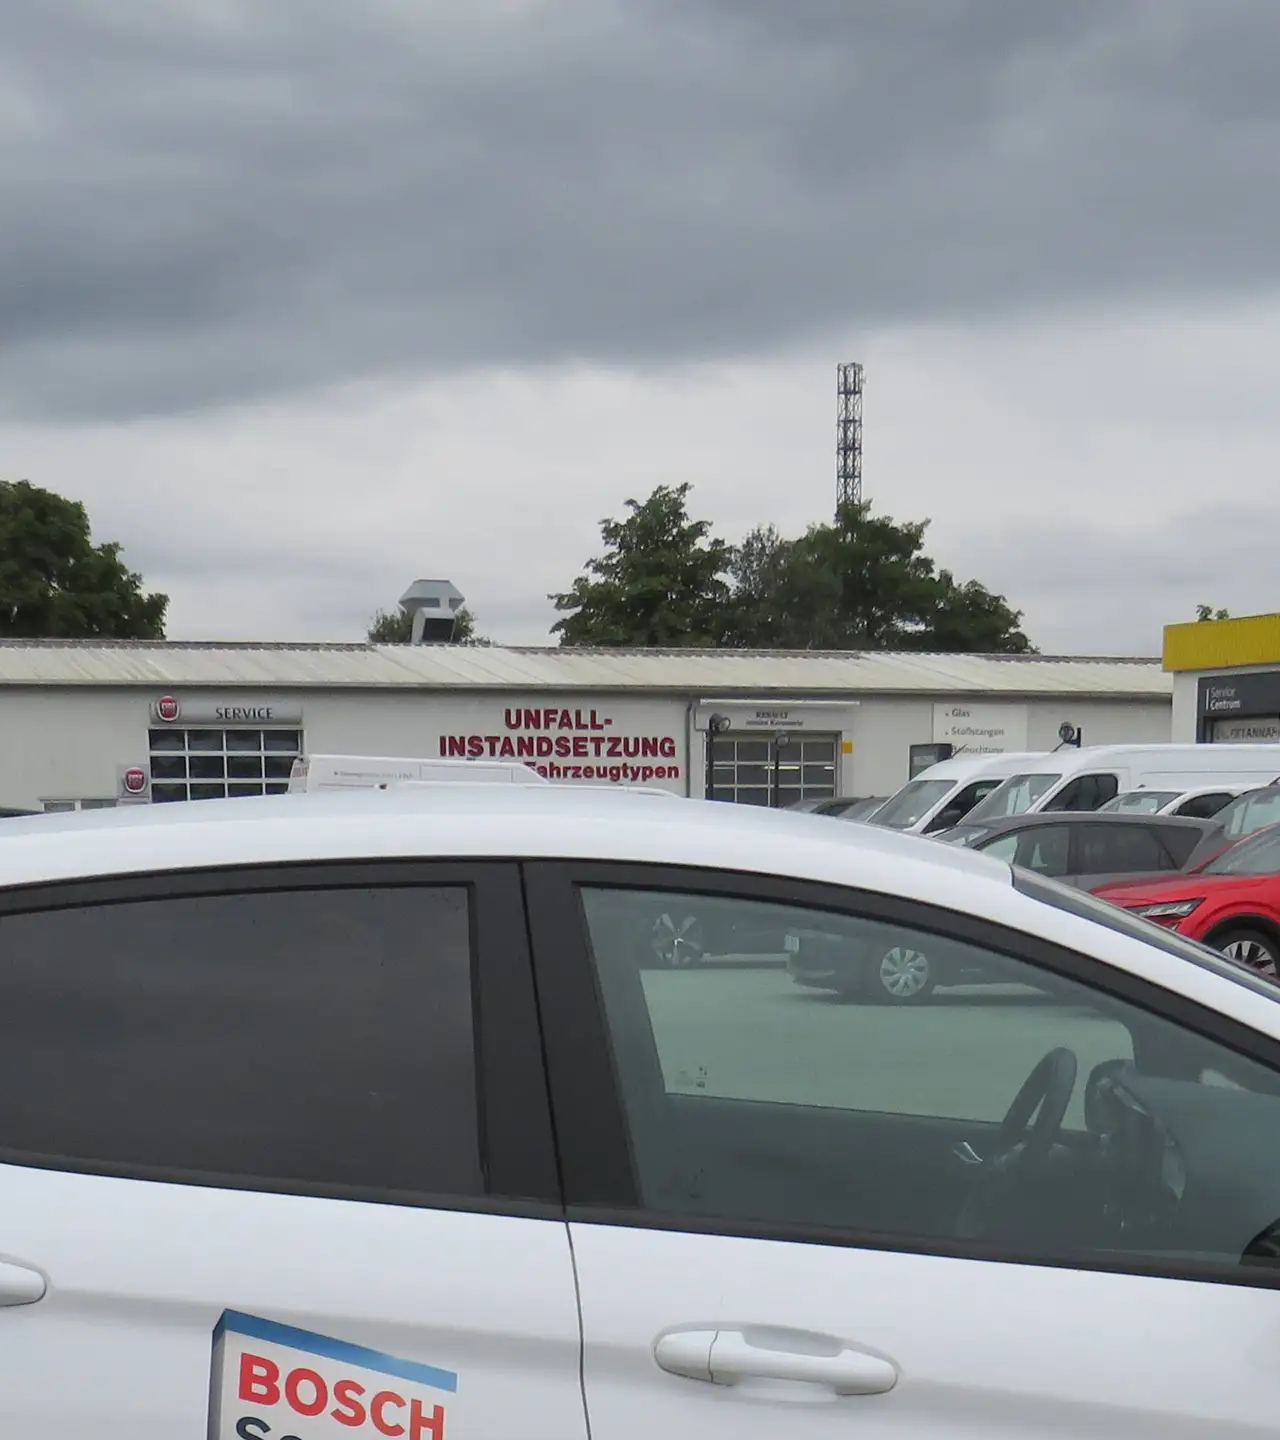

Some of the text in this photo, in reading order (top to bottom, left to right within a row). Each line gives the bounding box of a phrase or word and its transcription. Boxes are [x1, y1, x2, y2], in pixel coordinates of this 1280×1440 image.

[1210, 687, 1236, 698] Service
[1210, 699, 1241, 710] Centrum
[215, 707, 273, 719] SERVICE
[951, 708, 970, 717] Glas
[505, 708, 613, 730] UNFALL-
[439, 735, 676, 758] INSTANDSETZUNG
